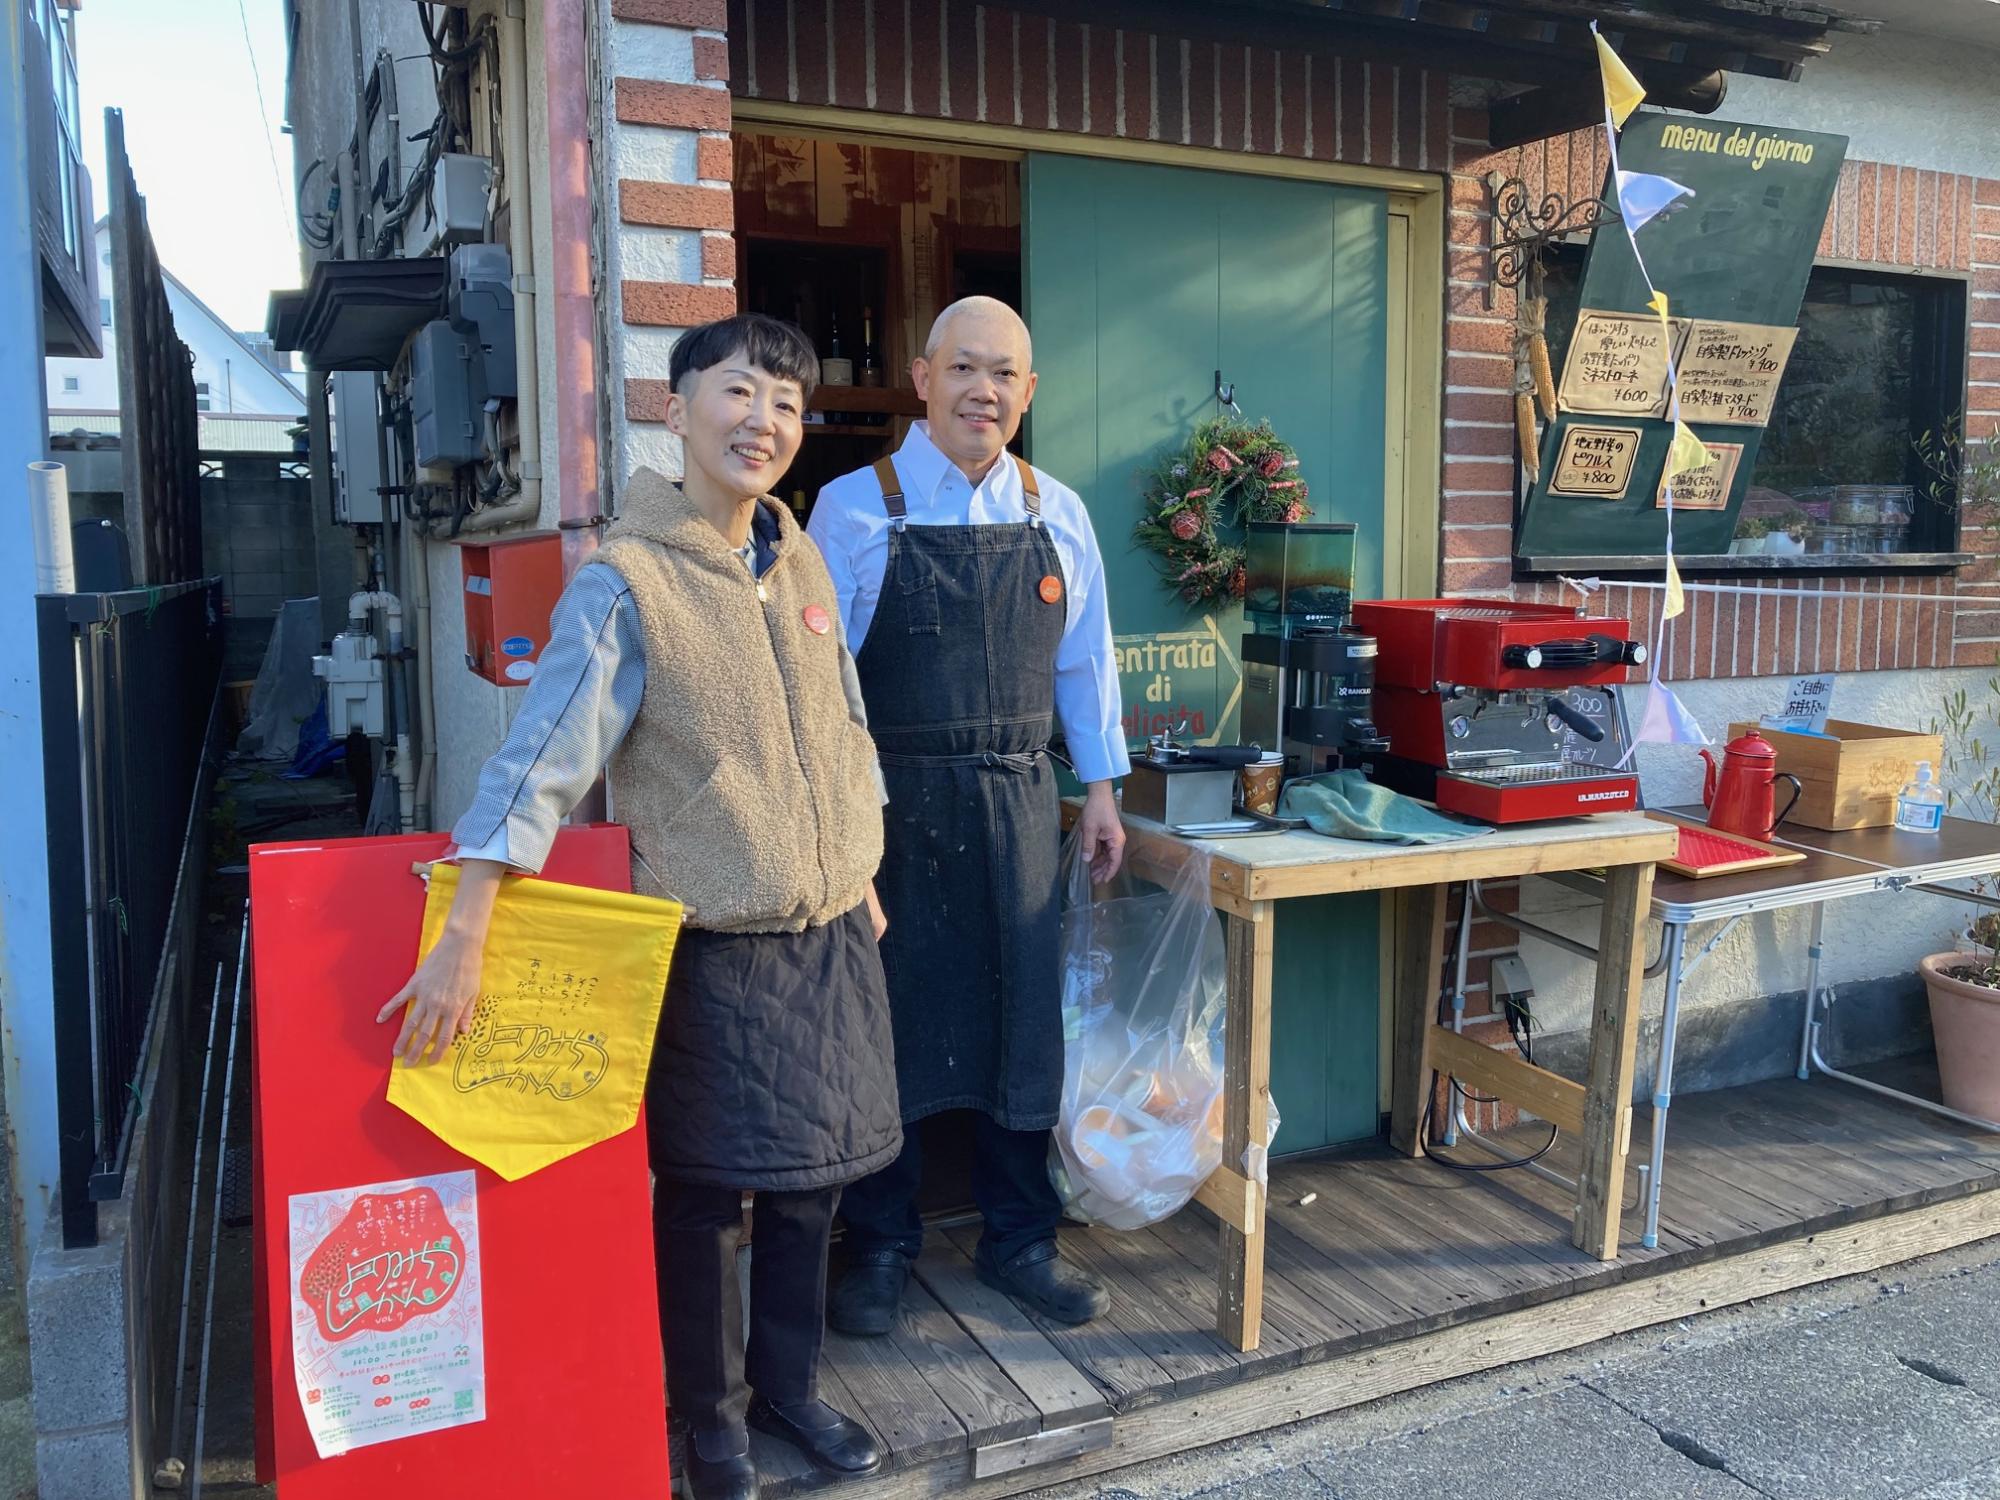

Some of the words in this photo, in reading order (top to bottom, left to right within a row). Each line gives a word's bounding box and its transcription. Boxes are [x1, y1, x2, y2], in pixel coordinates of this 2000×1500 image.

[1660, 124, 1721, 154] menu
[1723, 127, 1757, 158] del
[1751, 133, 1814, 171] giorno
[1696, 343, 1772, 360] 自家製ドレッシング
[1749, 358, 1779, 372] ¥400
[1581, 366, 1639, 383] ミネストローネ
[1613, 388, 1649, 402] ¥600
[1727, 406, 1758, 418] ¥700
[1574, 437, 1624, 453] 地元野菜の
[1572, 453, 1613, 468] ピクルス
[1582, 470, 1616, 484] ¥800
[1114, 639, 1217, 673] entrata
[1146, 674, 1172, 703] di
[1793, 678, 1830, 697] ご自由に
[1121, 703, 1206, 737] elicita
[353, 1356, 380, 1366] 11:00
